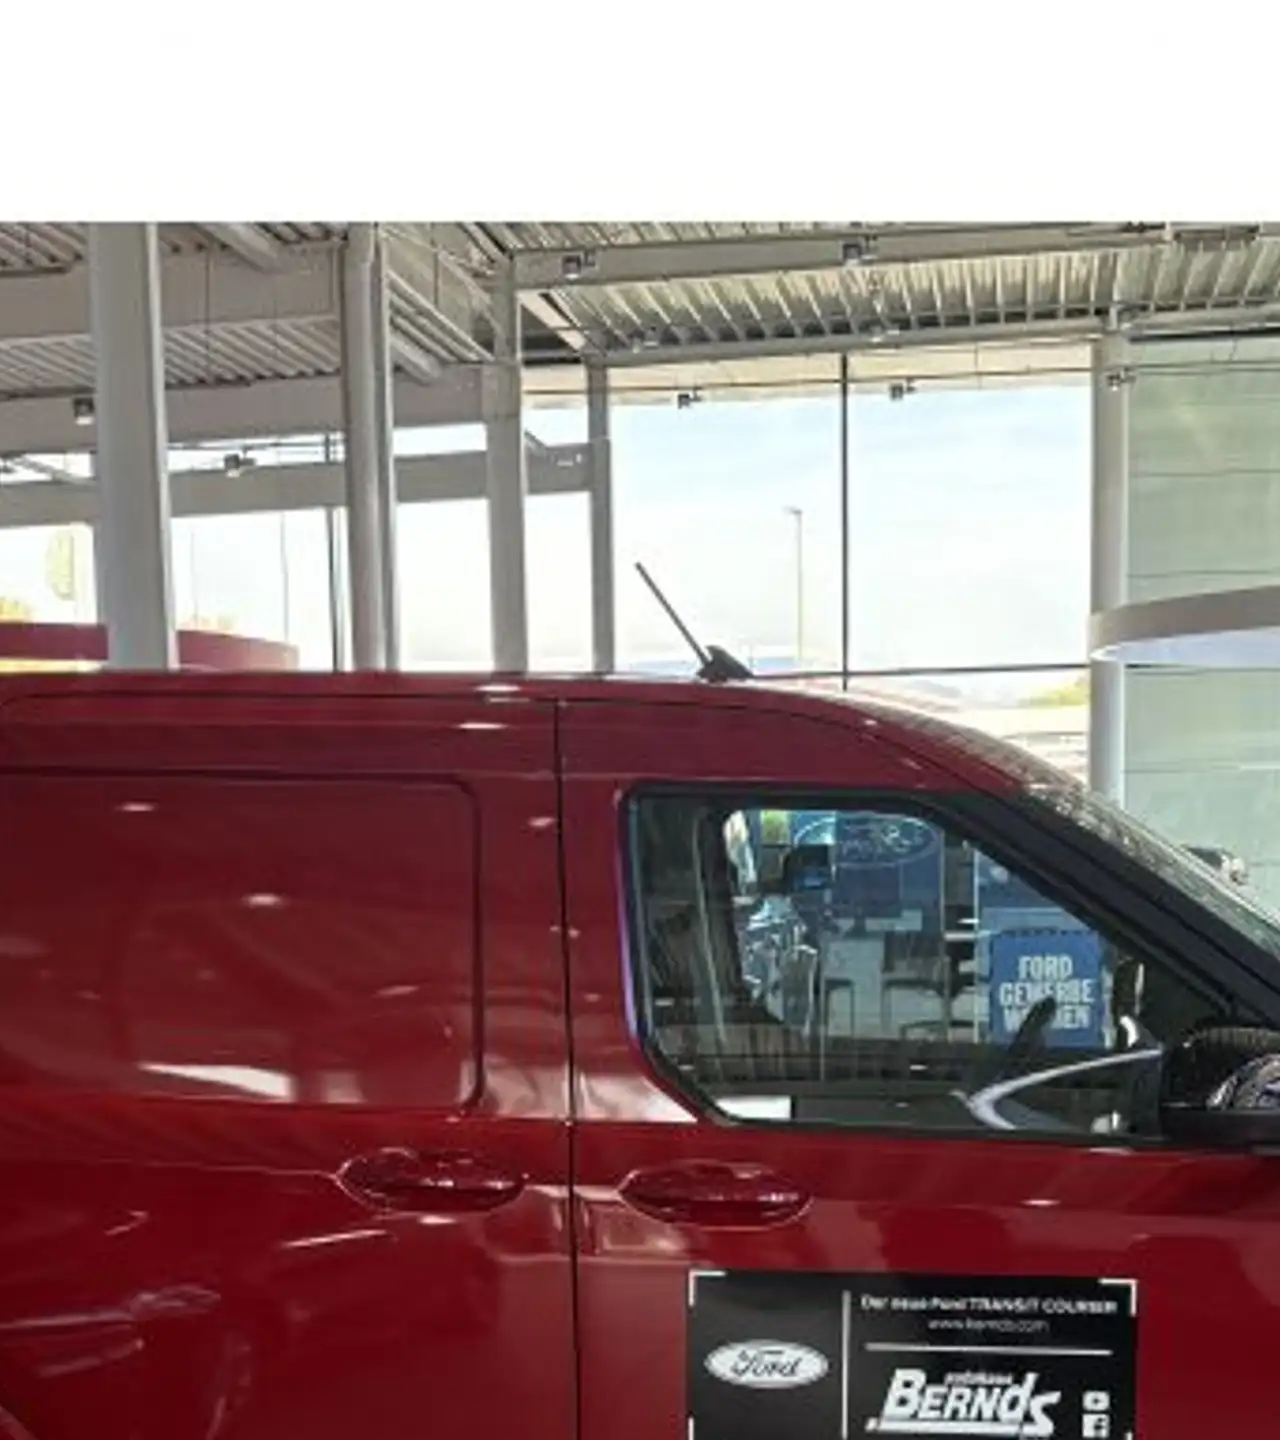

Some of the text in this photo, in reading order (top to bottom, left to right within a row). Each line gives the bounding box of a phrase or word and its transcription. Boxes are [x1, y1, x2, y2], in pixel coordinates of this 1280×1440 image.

[1019, 955, 1073, 979] FORD
[969, 1297, 1039, 1313] TRANSIT
[1041, 1298, 1118, 1315] COURIER
